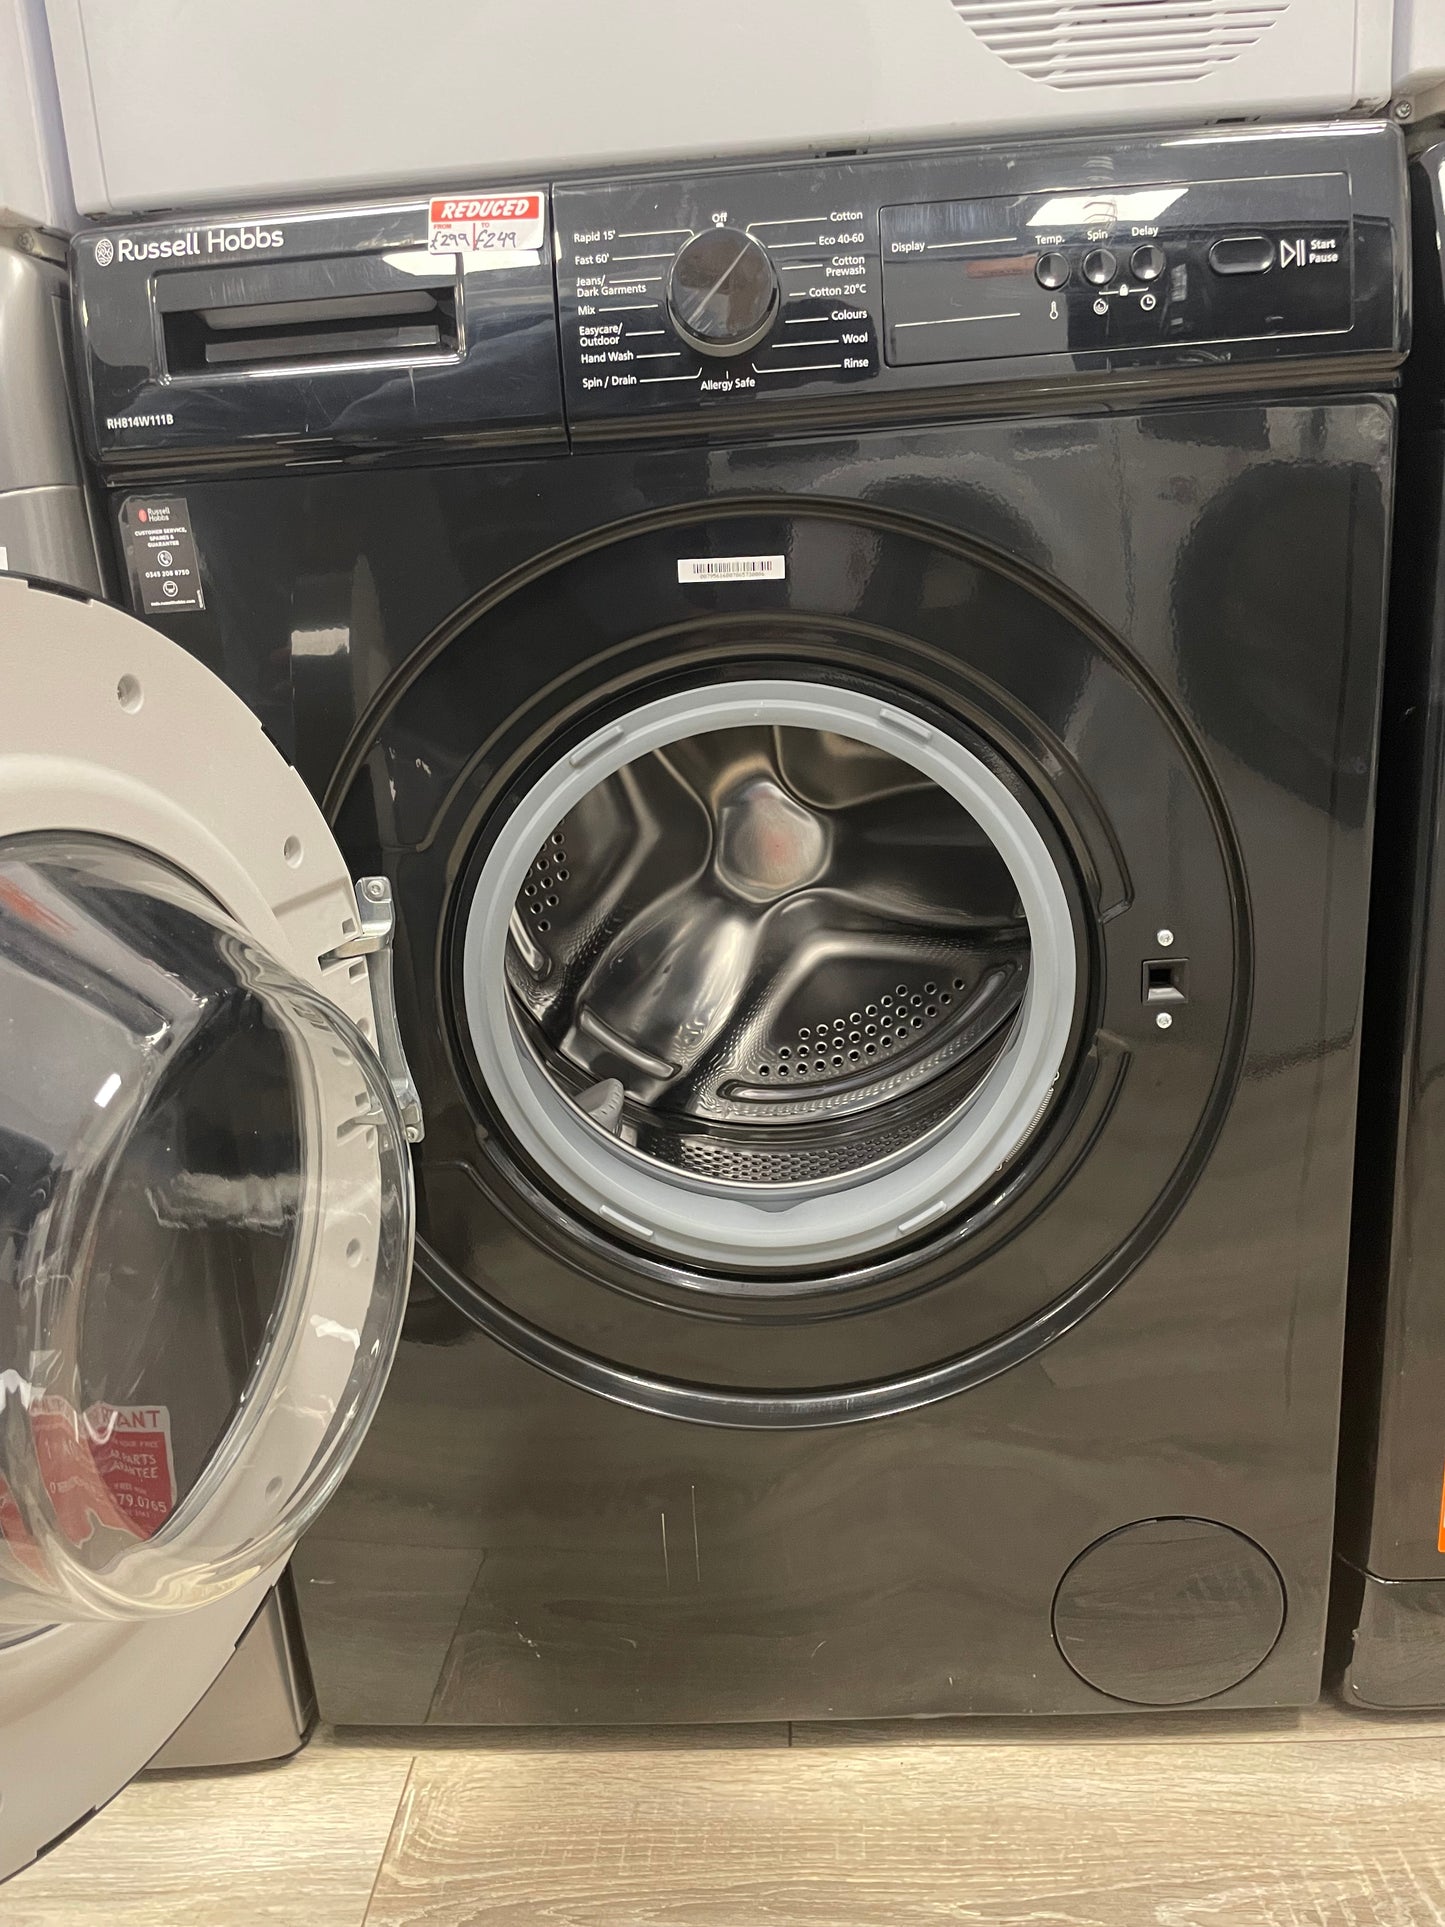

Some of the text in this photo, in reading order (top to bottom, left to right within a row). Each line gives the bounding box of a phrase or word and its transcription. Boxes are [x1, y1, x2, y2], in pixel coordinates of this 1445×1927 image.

[441, 199, 530, 219] REDUCED
[712, 212, 727, 223] Off
[830, 211, 863, 221] Cotton
[574, 231, 600, 243] Rapid
[1087, 228, 1108, 242] Spin
[1131, 224, 1158, 238] Delay
[118, 228, 285, 262] Russell Hobbs
[430, 231, 470, 250] £299
[473, 229, 516, 251] £249
[819, 233, 864, 246] Eco 40-60
[1035, 234, 1065, 248] Temp.
[1311, 239, 1336, 250] Start
[891, 239, 925, 255] Display
[575, 255, 594, 266] Fast
[832, 255, 865, 266] Cotton
[1309, 251, 1339, 264] Pause
[826, 265, 865, 277] Prewash
[576, 275, 606, 287] Jeans/
[577, 283, 647, 298] Dark Garments
[809, 284, 867, 298] Cotton 20°C
[578, 305, 596, 315] Mix
[831, 309, 867, 321] Colours
[579, 322, 623, 338] Easycare/
[580, 335, 619, 346] Outdoor
[842, 333, 868, 344] Wool
[581, 351, 634, 364] Hand Wash
[844, 358, 869, 369] Rinse
[582, 376, 604, 390] Spin
[610, 375, 637, 387] Drain
[700, 377, 756, 391] Allergy Safe
[106, 414, 174, 430] RH814W111B
[147, 507, 170, 515] Russell
[149, 514, 169, 522] Hobbs
